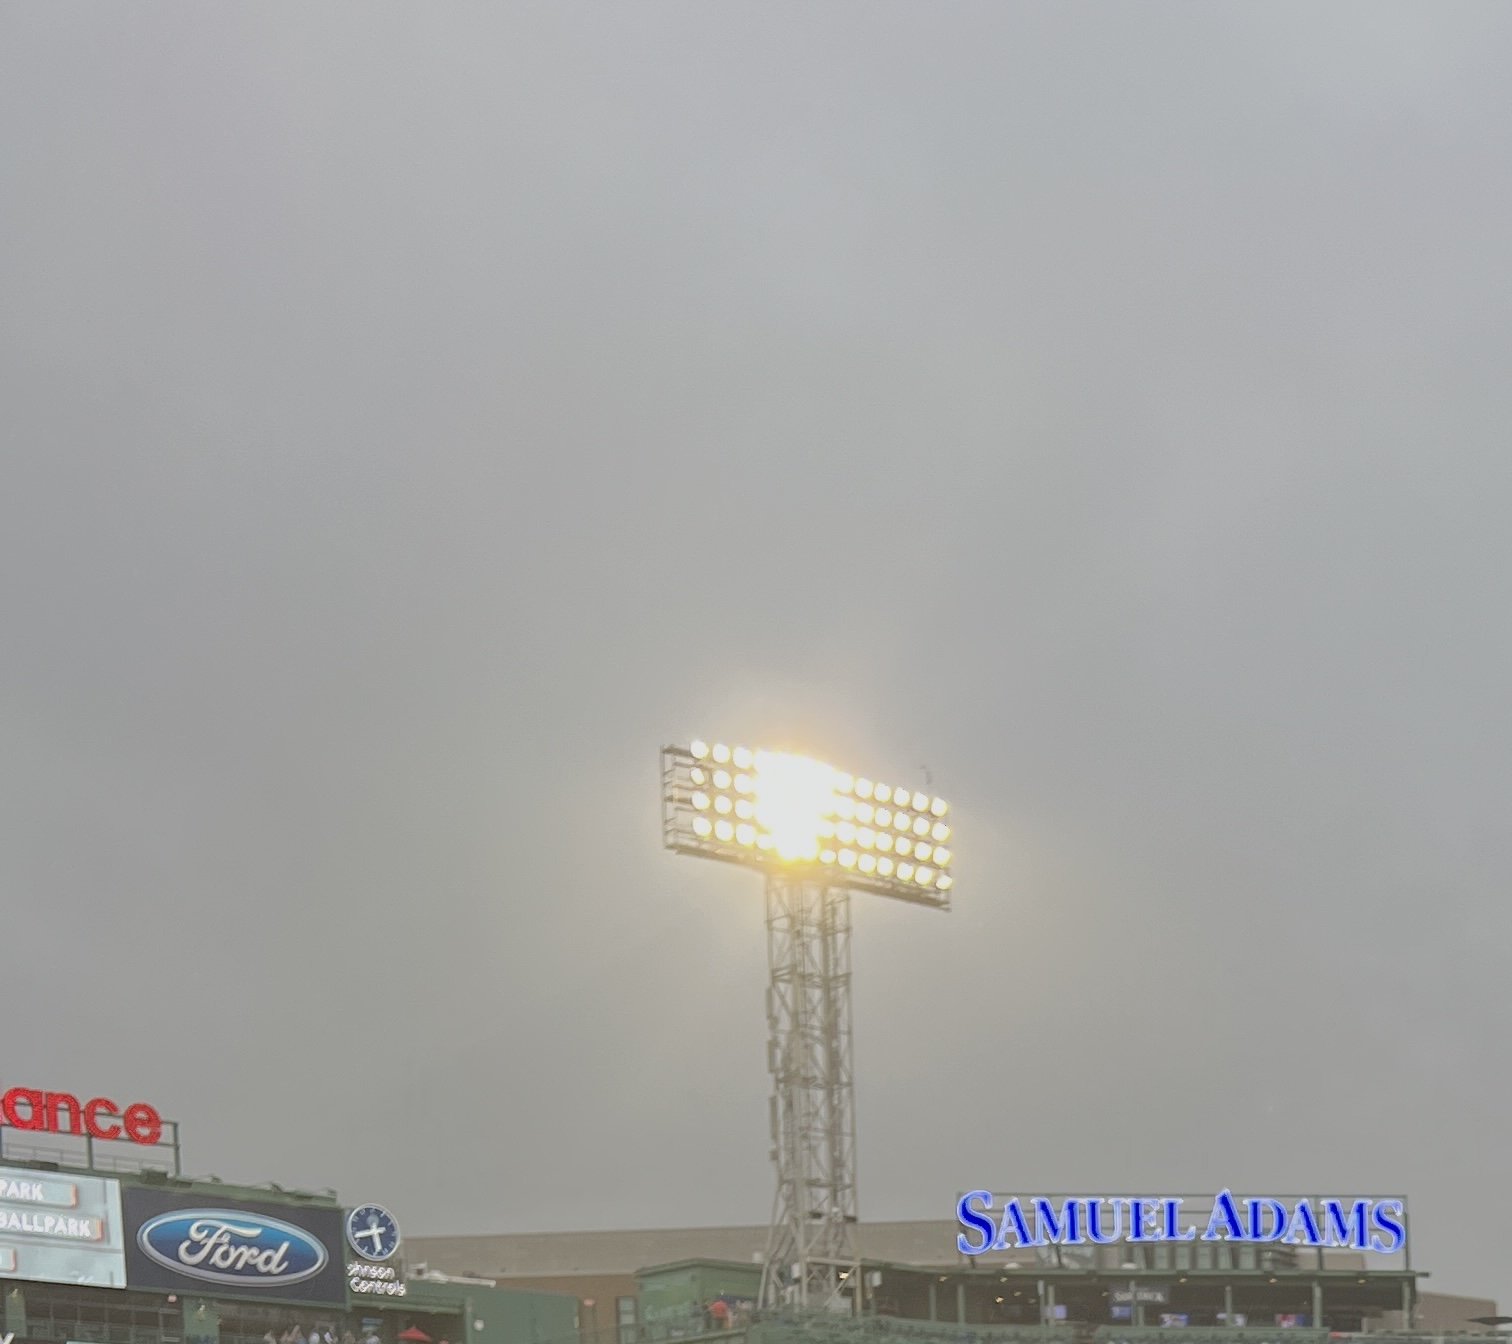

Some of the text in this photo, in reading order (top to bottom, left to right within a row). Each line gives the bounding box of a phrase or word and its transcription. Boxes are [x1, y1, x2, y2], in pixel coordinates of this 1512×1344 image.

[178, 1219, 291, 1276] Ford
[957, 1189, 1407, 1255] SAMUEL ADAMS
